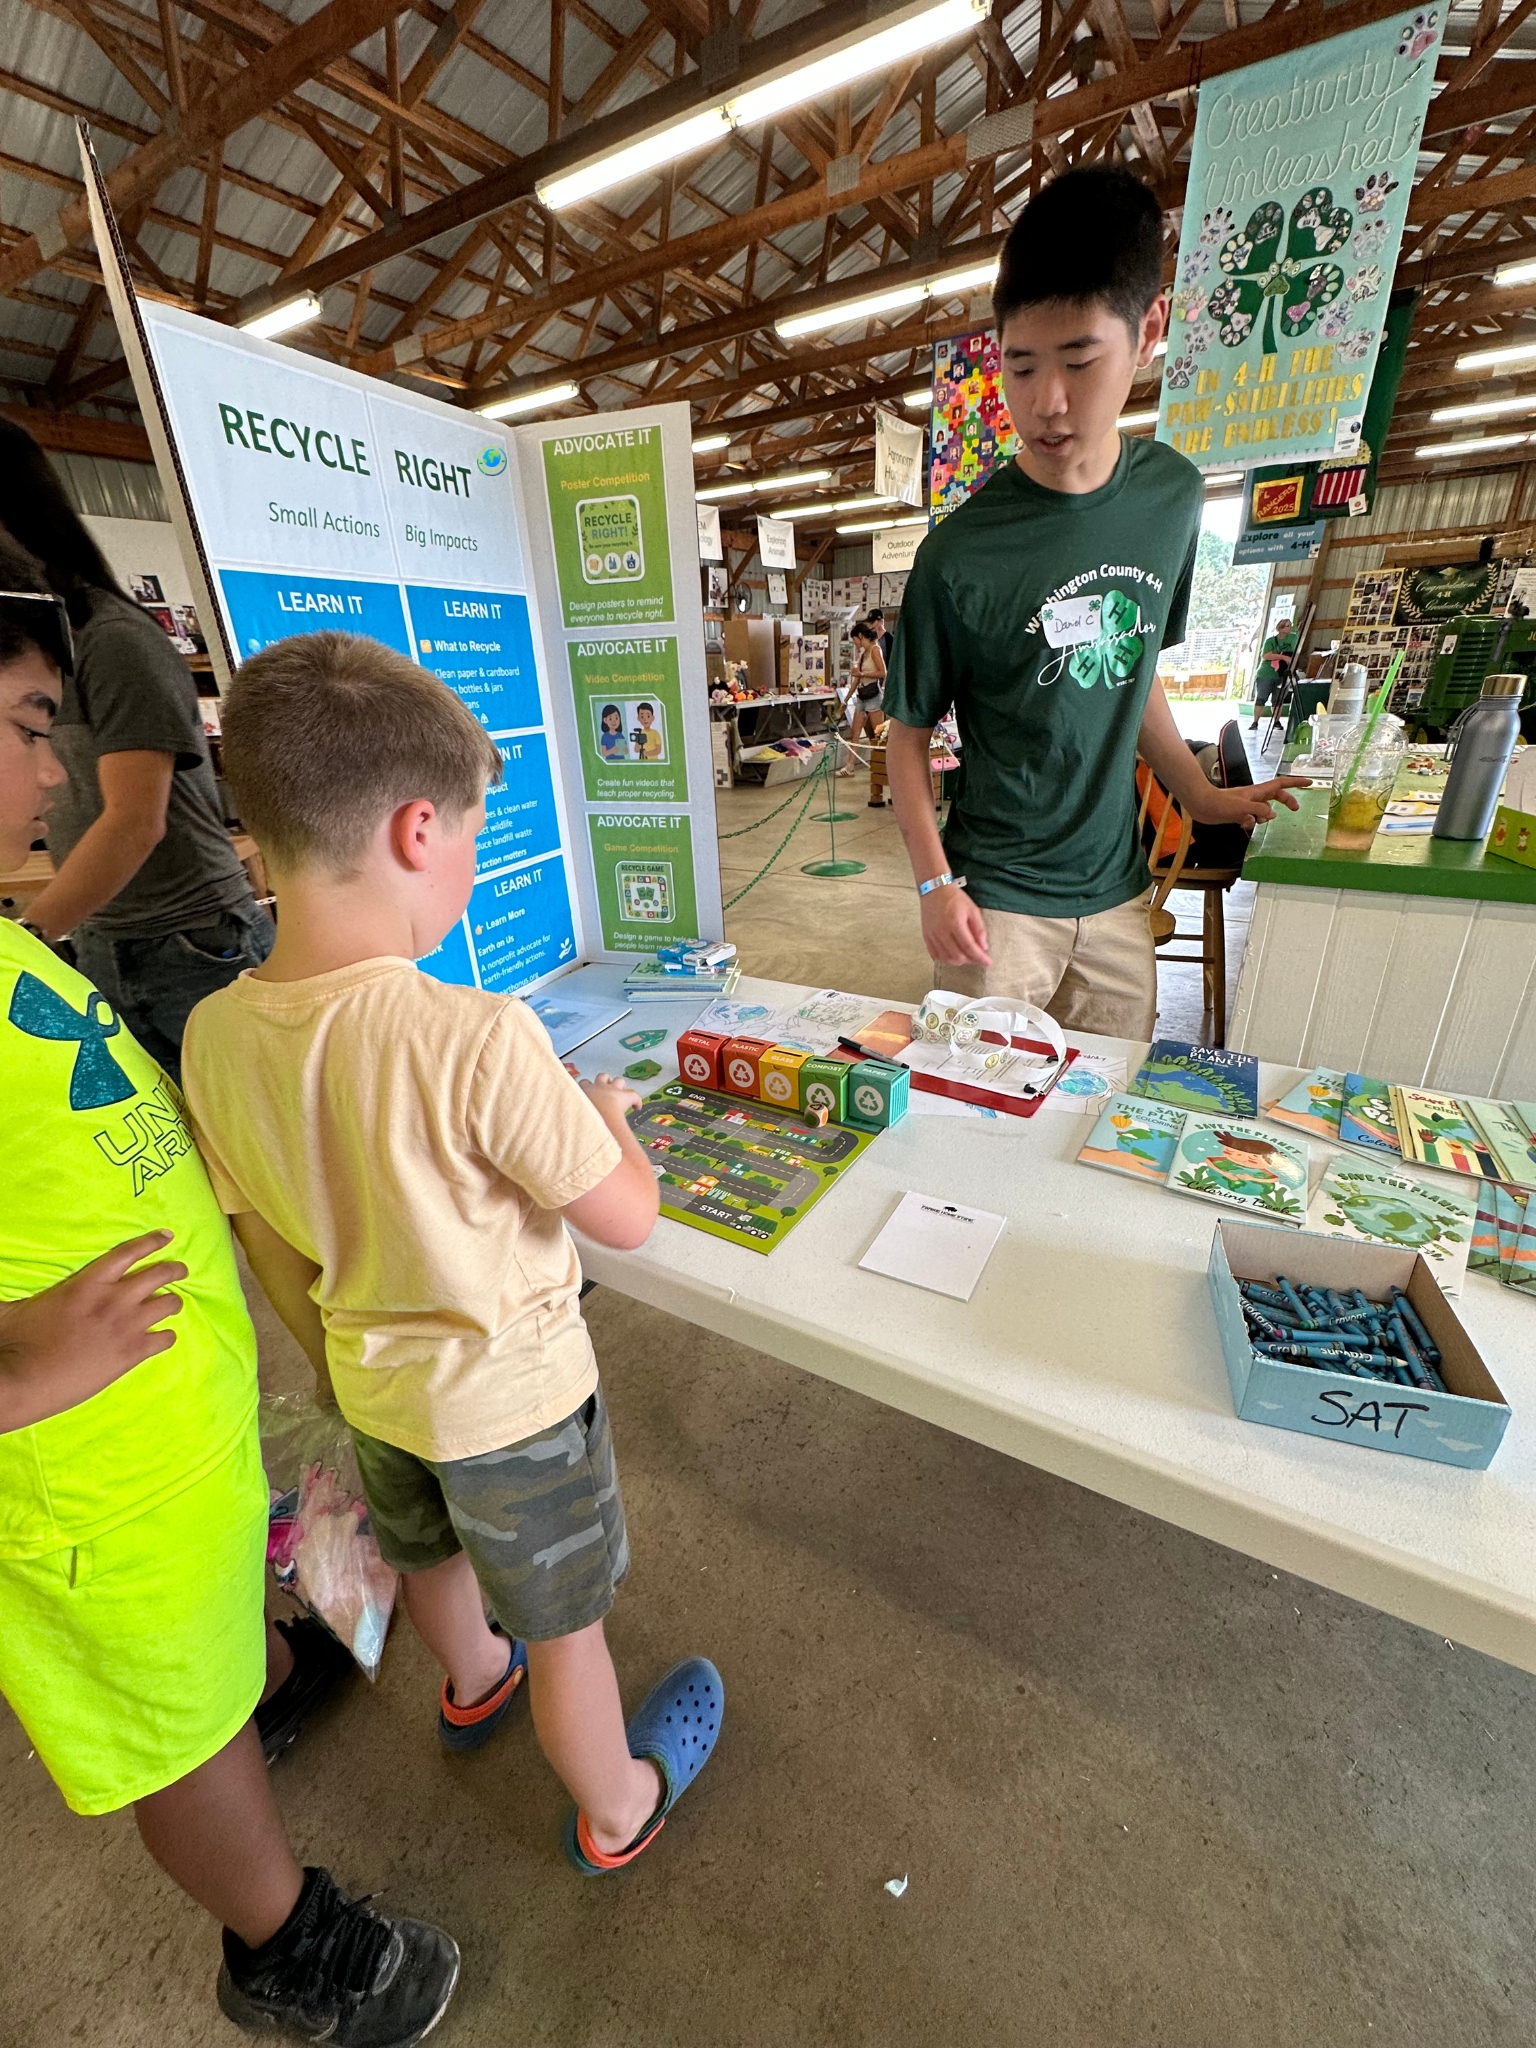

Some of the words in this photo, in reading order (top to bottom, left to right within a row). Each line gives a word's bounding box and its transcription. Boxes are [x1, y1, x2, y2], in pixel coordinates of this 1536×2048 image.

[1207, 48, 1410, 149] Creativity
[1206, 106, 1416, 210] Unleashed
[1195, 367, 1221, 396] IN
[1232, 354, 1278, 388] 4-H
[1289, 343, 1337, 377] THE
[1165, 372, 1365, 428] PAW-SSIBILITIES
[553, 429, 635, 457] ADVOCATE
[638, 427, 652, 446] IT
[1170, 427, 1213, 455] ARE
[218, 402, 372, 478] RECYCLE
[394, 448, 472, 499] RIGHT
[888, 445, 915, 468] Agronom
[561, 479, 591, 491] Poster
[593, 471, 650, 488] Competition
[930, 503, 960, 517] Countr
[1255, 485, 1296, 520] RANGERS
[1272, 502, 1295, 515] 2025
[268, 501, 318, 530] Small
[323, 513, 381, 539] Actions
[404, 524, 427, 548] Big
[430, 528, 478, 551] Impacts
[584, 512, 632, 528] RECYCLE
[592, 526, 628, 540] RIGHT!
[1241, 532, 1280, 543] Explore
[1297, 530, 1316, 539] your
[887, 540, 915, 550] Outdoor
[1238, 546, 1264, 556] options
[1267, 544, 1284, 552] with
[277, 590, 345, 614] LEARN
[348, 595, 363, 615] IT
[569, 600, 595, 612] Design
[597, 599, 625, 611] posters
[627, 598, 635, 607] to
[637, 596, 664, 607] remind
[1024, 569, 1098, 635] Wahington
[1100, 564, 1146, 583] County
[1145, 573, 1164, 594] 4-H
[443, 600, 489, 619] LEARN
[491, 604, 502, 620] IT
[570, 612, 604, 624] everyone
[606, 611, 614, 621] to
[616, 610, 643, 622] recycle
[645, 609, 664, 621] right.
[1108, 601, 1129, 625] H
[1053, 616, 1082, 634] Daniel
[1085, 614, 1095, 626] C
[433, 640, 457, 652] What
[457, 640, 468, 652] to
[469, 640, 501, 654] Recycle
[577, 640, 653, 657] ADVOCATE
[655, 639, 668, 653] IT
[1037, 605, 1157, 686] Ambassador
[1113, 644, 1135, 667] H
[434, 668, 456, 679] Clean
[457, 668, 478, 680] paper
[479, 667, 486, 677] &
[486, 666, 520, 677] cardboard
[1077, 655, 1096, 680] H
[585, 674, 610, 684] Video
[611, 672, 665, 685] Competition
[458, 684, 483, 695] bottles
[484, 683, 490, 692] &
[491, 684, 504, 695] jars
[512, 744, 523, 760] IT
[485, 782, 509, 796] mpact
[597, 778, 621, 787] Create
[622, 778, 634, 787] fun
[636, 778, 659, 787] videos
[660, 778, 675, 787] that
[597, 789, 616, 798] teach
[618, 790, 641, 799] proper
[642, 790, 676, 800] recycling.
[485, 809, 496, 820] ees
[497, 806, 503, 816] &
[504, 803, 520, 815] clean
[521, 799, 538, 811] water
[489, 820, 513, 833] wildlife
[597, 815, 667, 829] ADVOCATE
[670, 817, 682, 829] IT
[476, 840, 492, 851] duce
[492, 832, 514, 846] landfill
[515, 829, 533, 841] waste
[604, 843, 628, 852] Game
[629, 844, 679, 854] Competition
[481, 856, 502, 870] action
[503, 849, 527, 863] matters
[621, 865, 646, 873] RECYCLE
[647, 865, 665, 873] GAME
[494, 873, 532, 898] LEARN
[533, 869, 543, 882] IT
[485, 914, 507, 931] Learn
[508, 908, 526, 922] More
[477, 942, 496, 957] Earth
[496, 940, 505, 949] on
[506, 935, 515, 945] Us
[613, 932, 637, 943] Design
[644, 935, 663, 944] game
[664, 935, 672, 943] to
[481, 963, 487, 973] A
[487, 950, 516, 970] nonprofit
[516, 940, 543, 957] advocate
[542, 934, 551, 944] for
[614, 942, 637, 951] people
[638, 943, 655, 951] learn
[483, 959, 525, 986] earth-friendly
[525, 950, 547, 965] actions.
[687, 1036, 711, 1047] METAL
[731, 1043, 761, 1053] PLASTIC
[771, 1054, 795, 1064] GLASS
[1189, 1052, 1245, 1068] PLANET
[1190, 1046, 1221, 1057] SAVE
[1227, 1052, 1255, 1065] THE
[806, 1063, 844, 1073] COMPOST
[862, 1067, 888, 1078] PAPER
[1316, 1074, 1345, 1088] THE
[688, 1092, 707, 1102] END
[1408, 1093, 1445, 1106] Save
[1116, 1102, 1144, 1114] THE
[1155, 1106, 1187, 1120] SAV
[1424, 1103, 1462, 1117] color
[1134, 1114, 1179, 1130] COLORING
[1194, 1123, 1225, 1132] SAVE
[1228, 1124, 1252, 1134] THE
[1254, 1131, 1304, 1155] PLANET
[1186, 1180, 1248, 1204] Coloring
[1252, 1197, 1293, 1216] Book
[1337, 1172, 1375, 1183] SAVE
[1378, 1176, 1407, 1190] THE
[1410, 1186, 1471, 1218] PLANET
[699, 1203, 734, 1220] START
[1310, 1390, 1430, 1439] SAT
